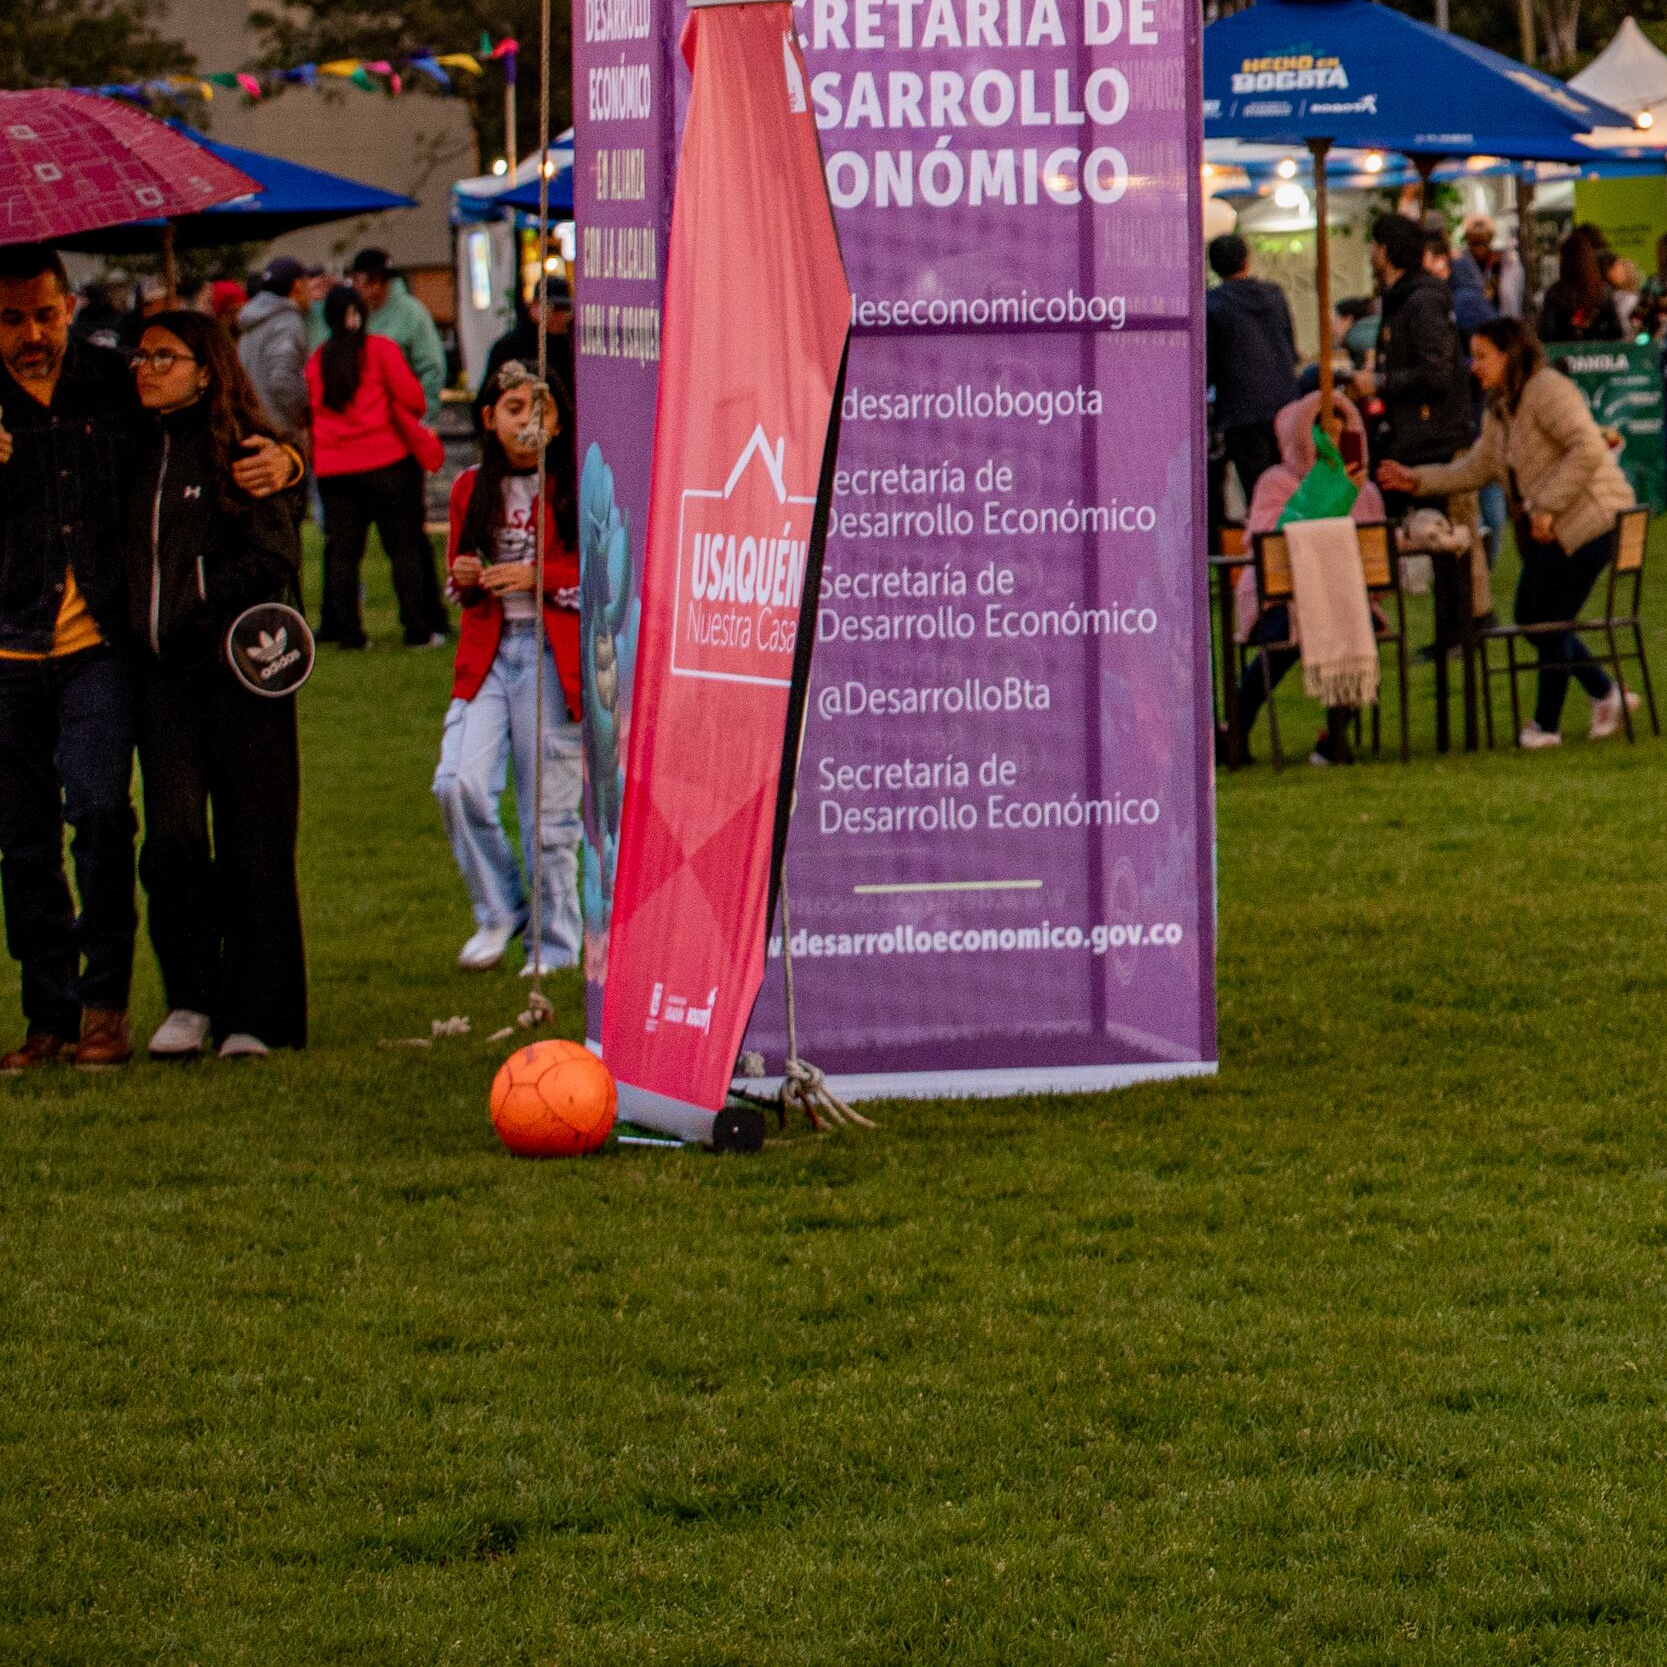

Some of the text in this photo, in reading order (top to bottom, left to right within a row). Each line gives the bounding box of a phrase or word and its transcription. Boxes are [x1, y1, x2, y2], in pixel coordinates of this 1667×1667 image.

[810, 67, 1130, 129] SARROLLO
[825, 135, 1129, 209] ONÓMICO
[850, 289, 1127, 330] eseconomicobog
[832, 459, 1013, 496] ecretaría de
[984, 498, 1156, 535] Económico
[977, 562, 1015, 595] de
[687, 600, 797, 653] Nuestra Casa
[817, 602, 1158, 643] Desarrollo Económico
[817, 677, 1051, 720] @DesarrolloBta
[818, 753, 1018, 791] Secretaría de
[819, 792, 1161, 835] Desarrollo Económico
